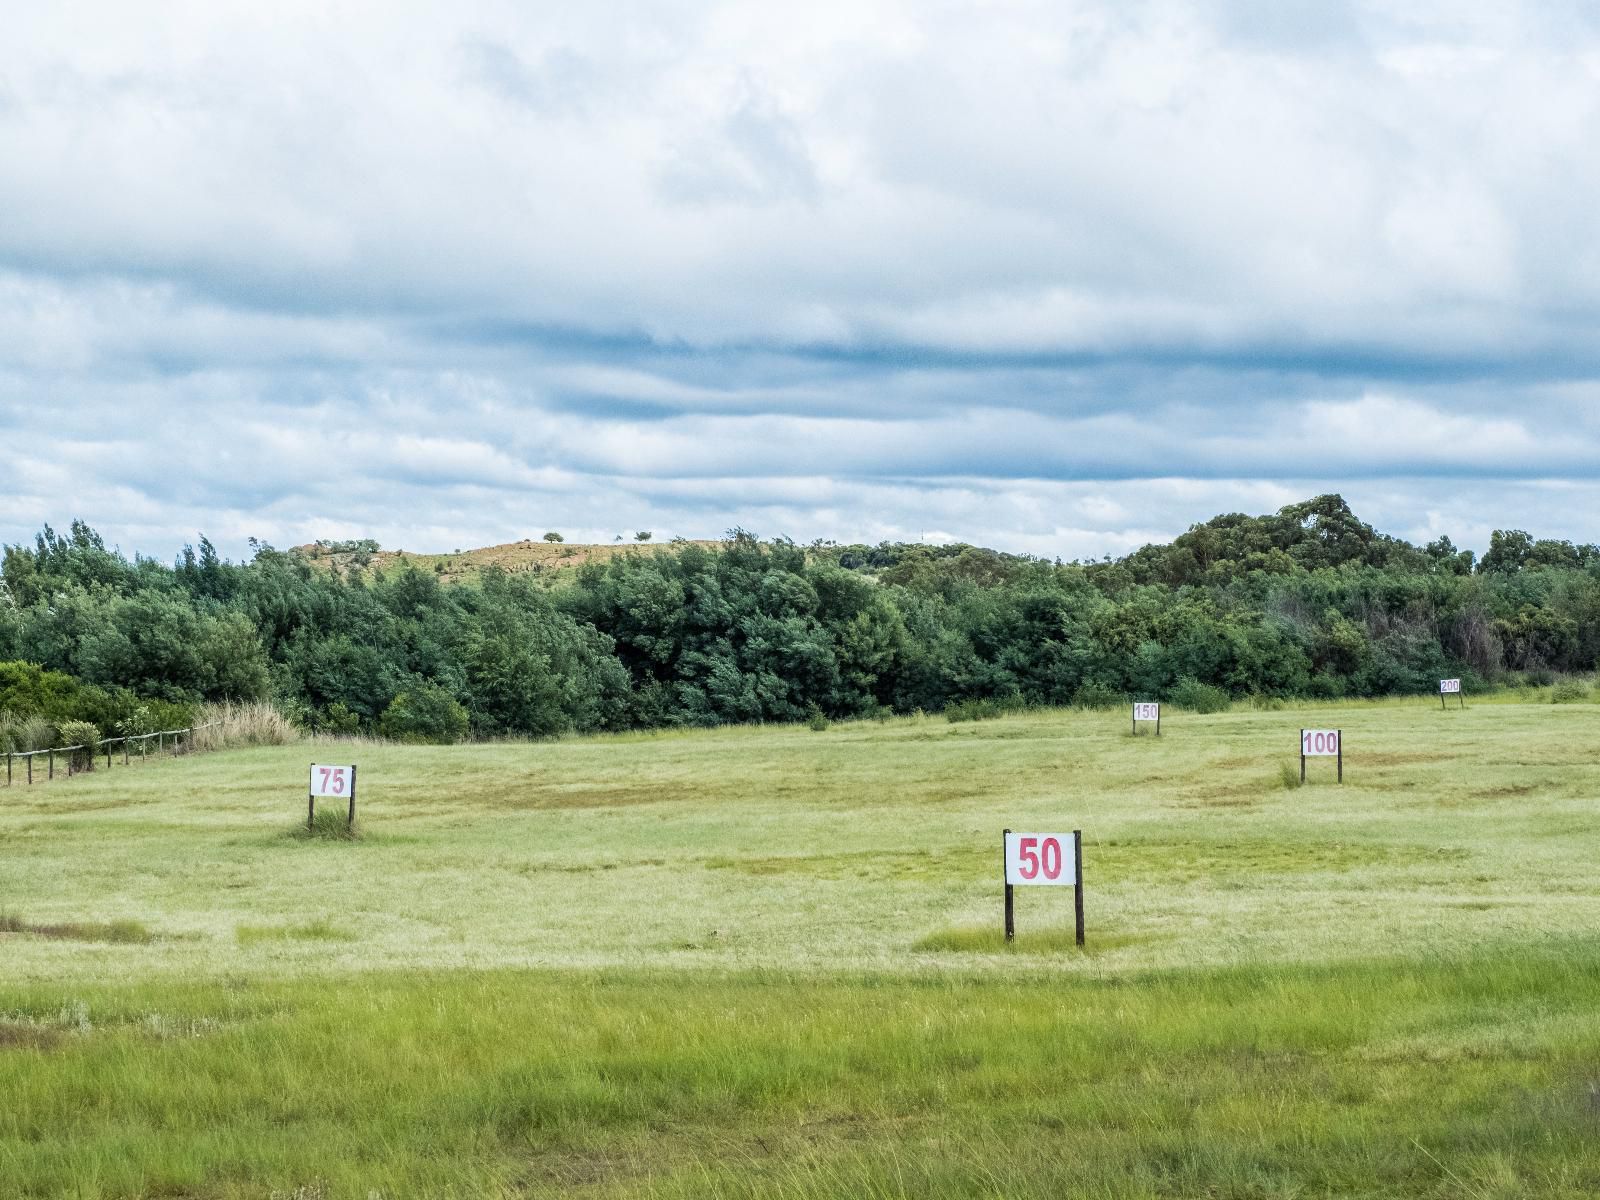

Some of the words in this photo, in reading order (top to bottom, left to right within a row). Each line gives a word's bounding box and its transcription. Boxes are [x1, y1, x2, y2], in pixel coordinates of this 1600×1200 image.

[1441, 680, 1459, 692] 200
[1136, 704, 1157, 719] 150
[1304, 732, 1337, 753] 100
[319, 768, 345, 794] 75
[1019, 837, 1062, 880] 50
